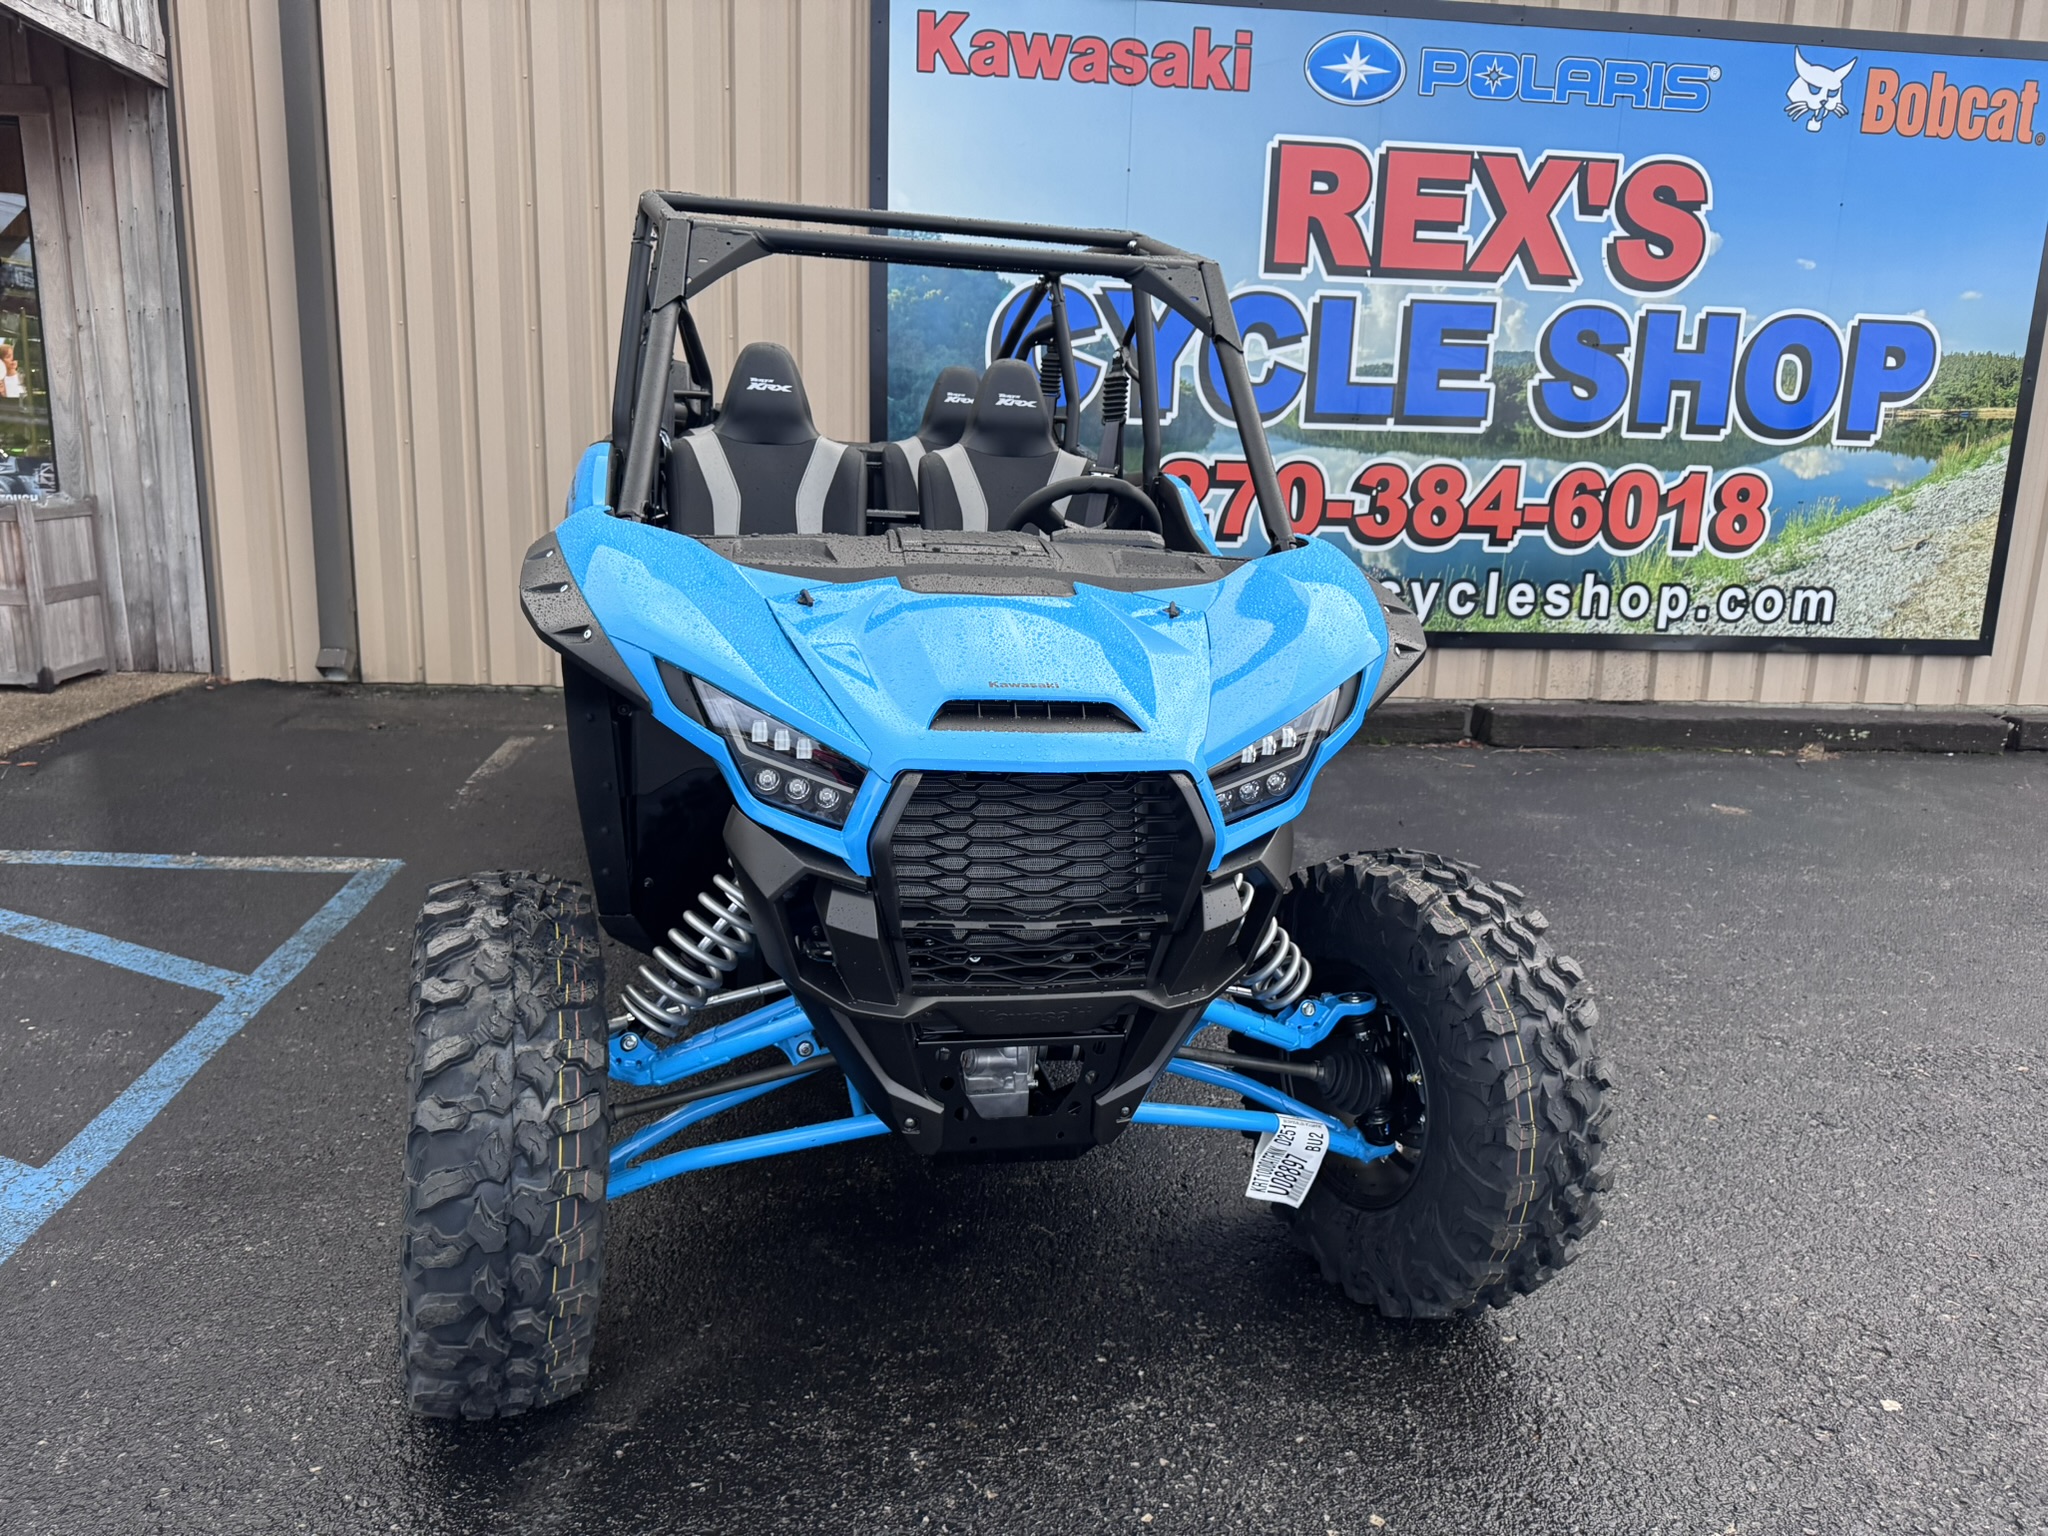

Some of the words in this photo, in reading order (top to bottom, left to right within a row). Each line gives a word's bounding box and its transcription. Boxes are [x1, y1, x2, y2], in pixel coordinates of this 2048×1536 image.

[916, 10, 1253, 92] Kawasaki
[1263, 138, 1710, 295] REX'S
[987, 281, 1499, 431] CYCLE
[1530, 301, 1938, 444] SHOP
[746, 382, 793, 392] KRX
[995, 398, 1037, 408] KRX
[988, 681, 1060, 689] Kawasaki
[1305, 1132, 1324, 1152] BU2
[1267, 1153, 1308, 1196] U08897
